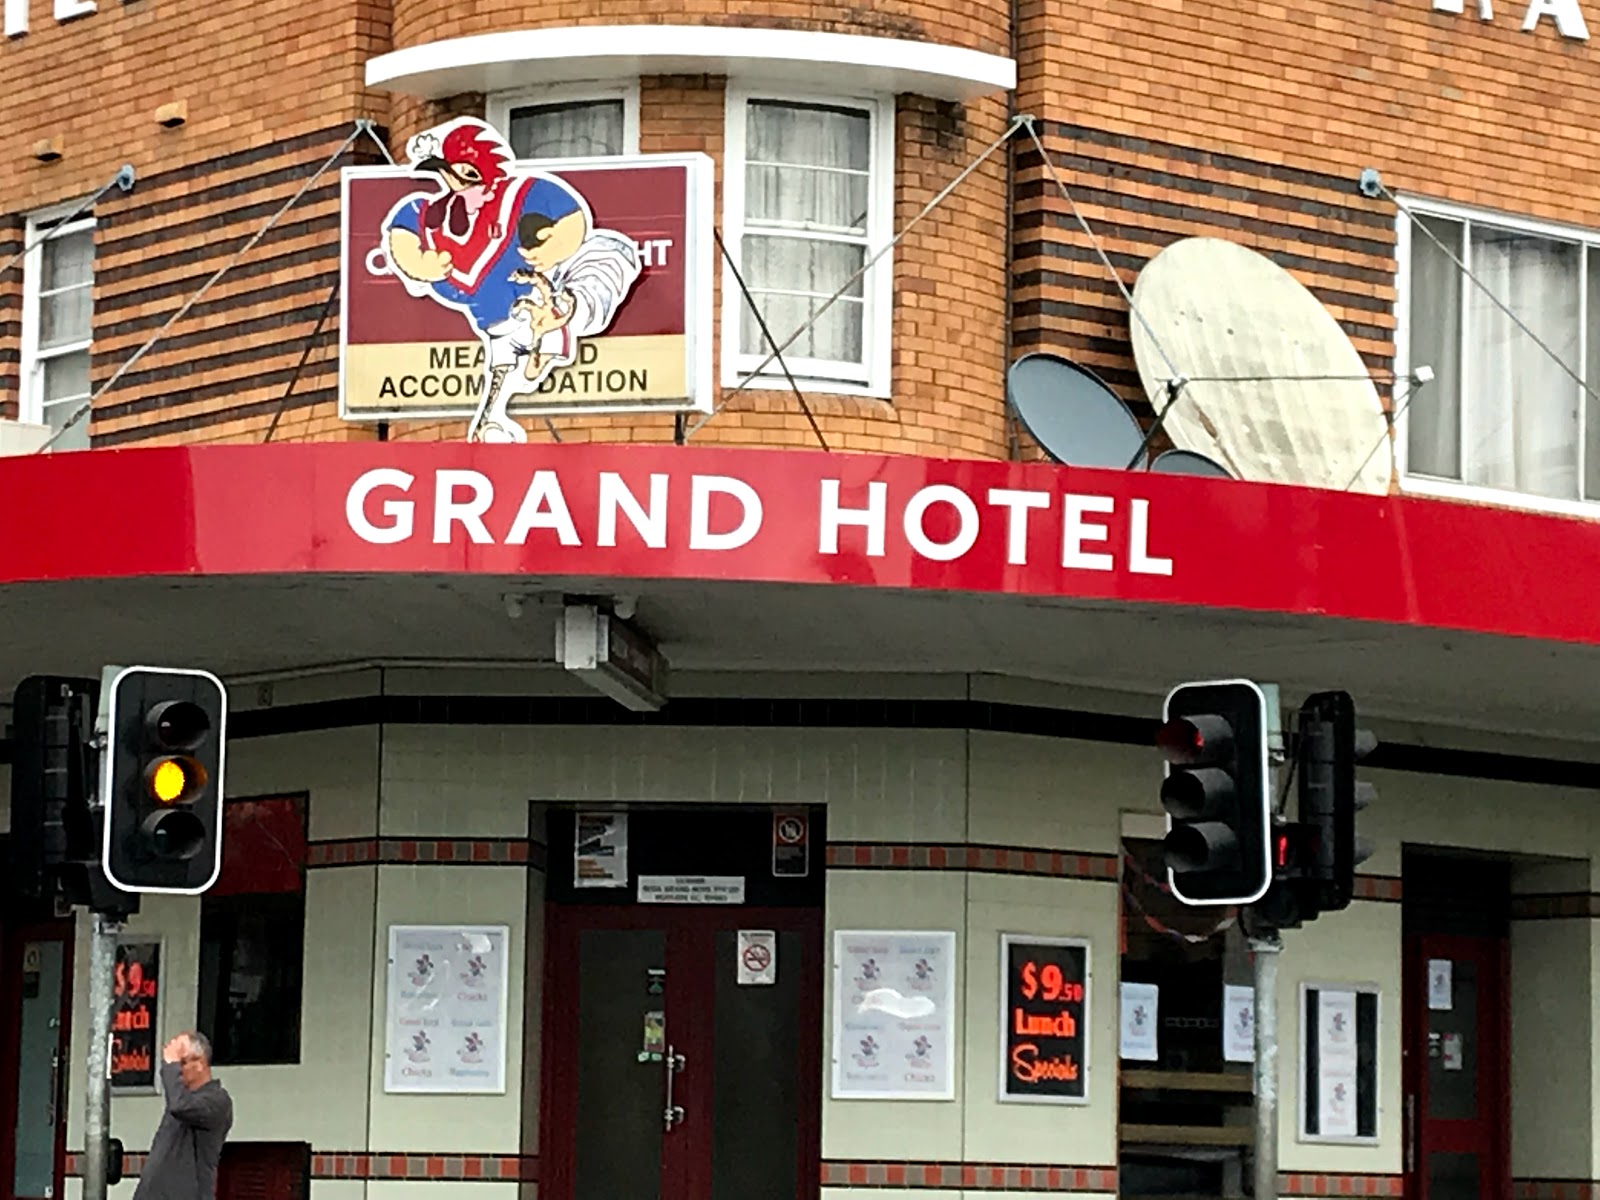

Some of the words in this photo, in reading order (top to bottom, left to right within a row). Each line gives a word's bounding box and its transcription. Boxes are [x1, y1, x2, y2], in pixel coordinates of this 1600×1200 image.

[429, 346, 486, 369] MEA
[379, 369, 647, 398] ACCOMDATION
[346, 469, 762, 549] GRAND
[819, 480, 1172, 575] HOTEL
[1015, 1008, 1076, 1037] Lunch
